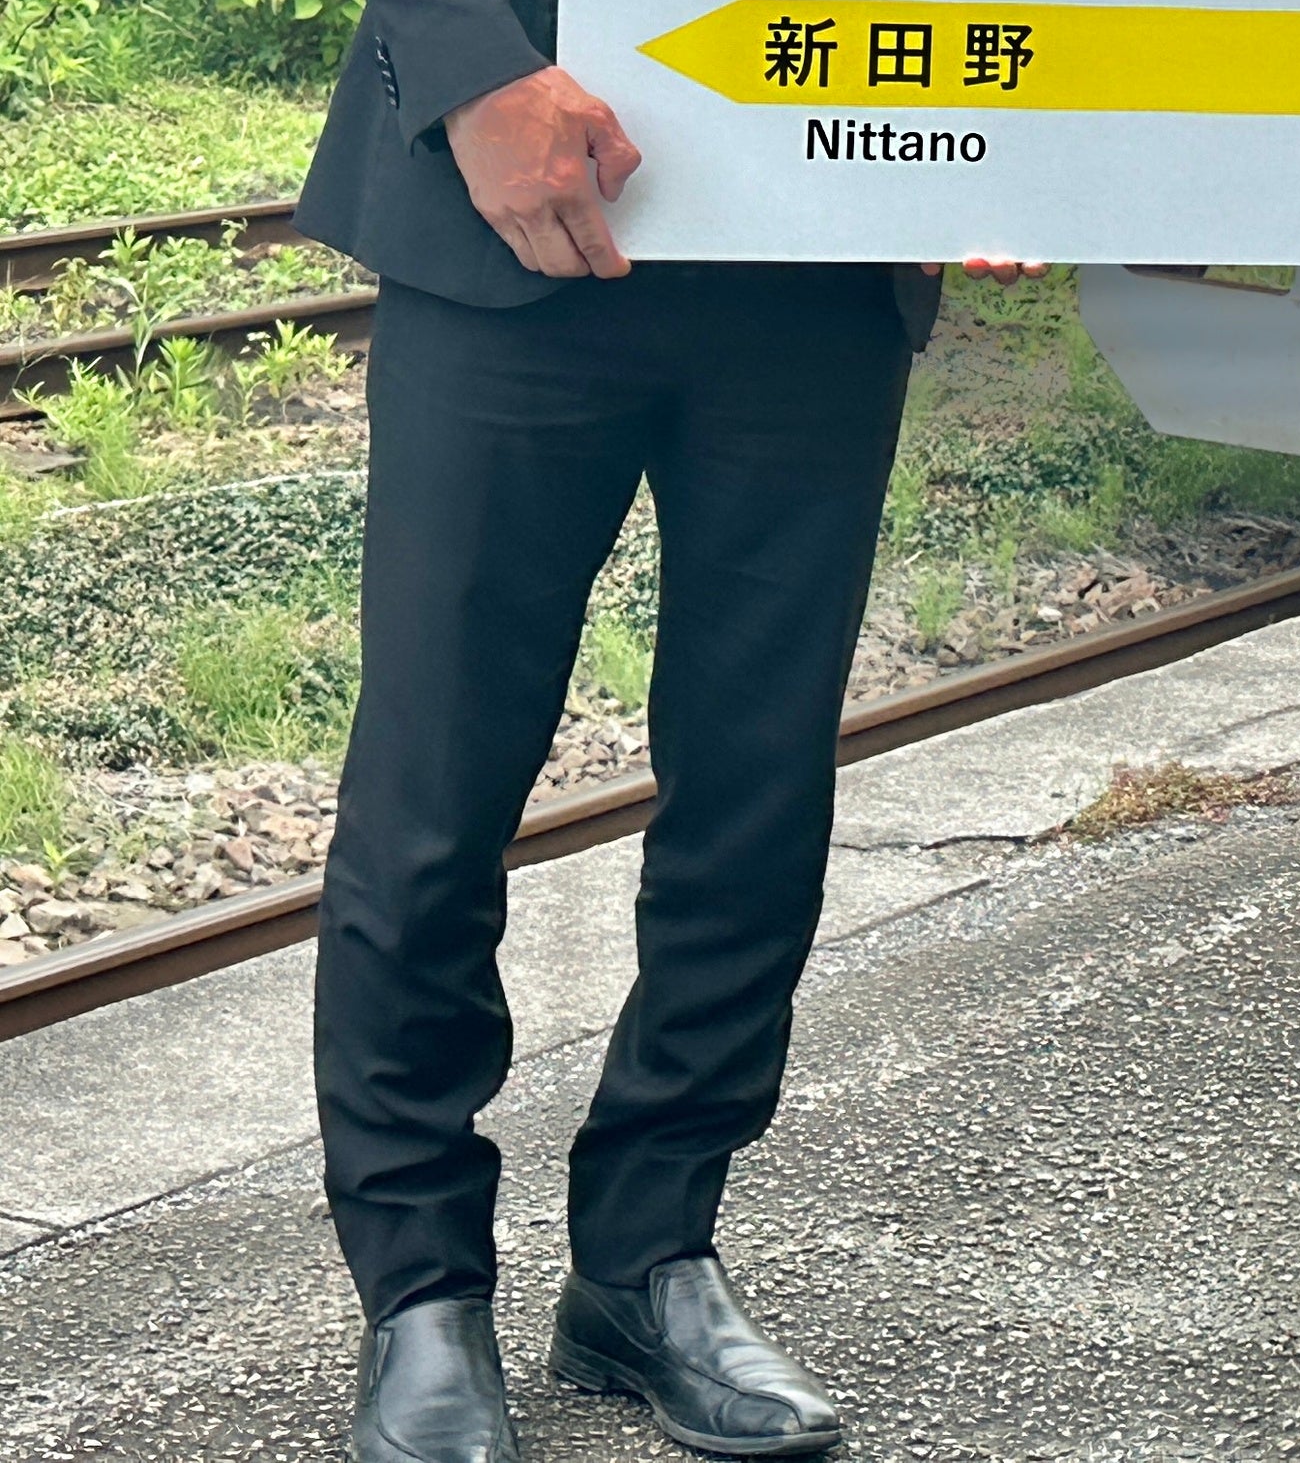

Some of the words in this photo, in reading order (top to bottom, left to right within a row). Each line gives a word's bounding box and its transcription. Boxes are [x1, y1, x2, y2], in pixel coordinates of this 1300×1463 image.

[764, 16, 1034, 91] 新田野
[806, 119, 987, 163] Nittano
